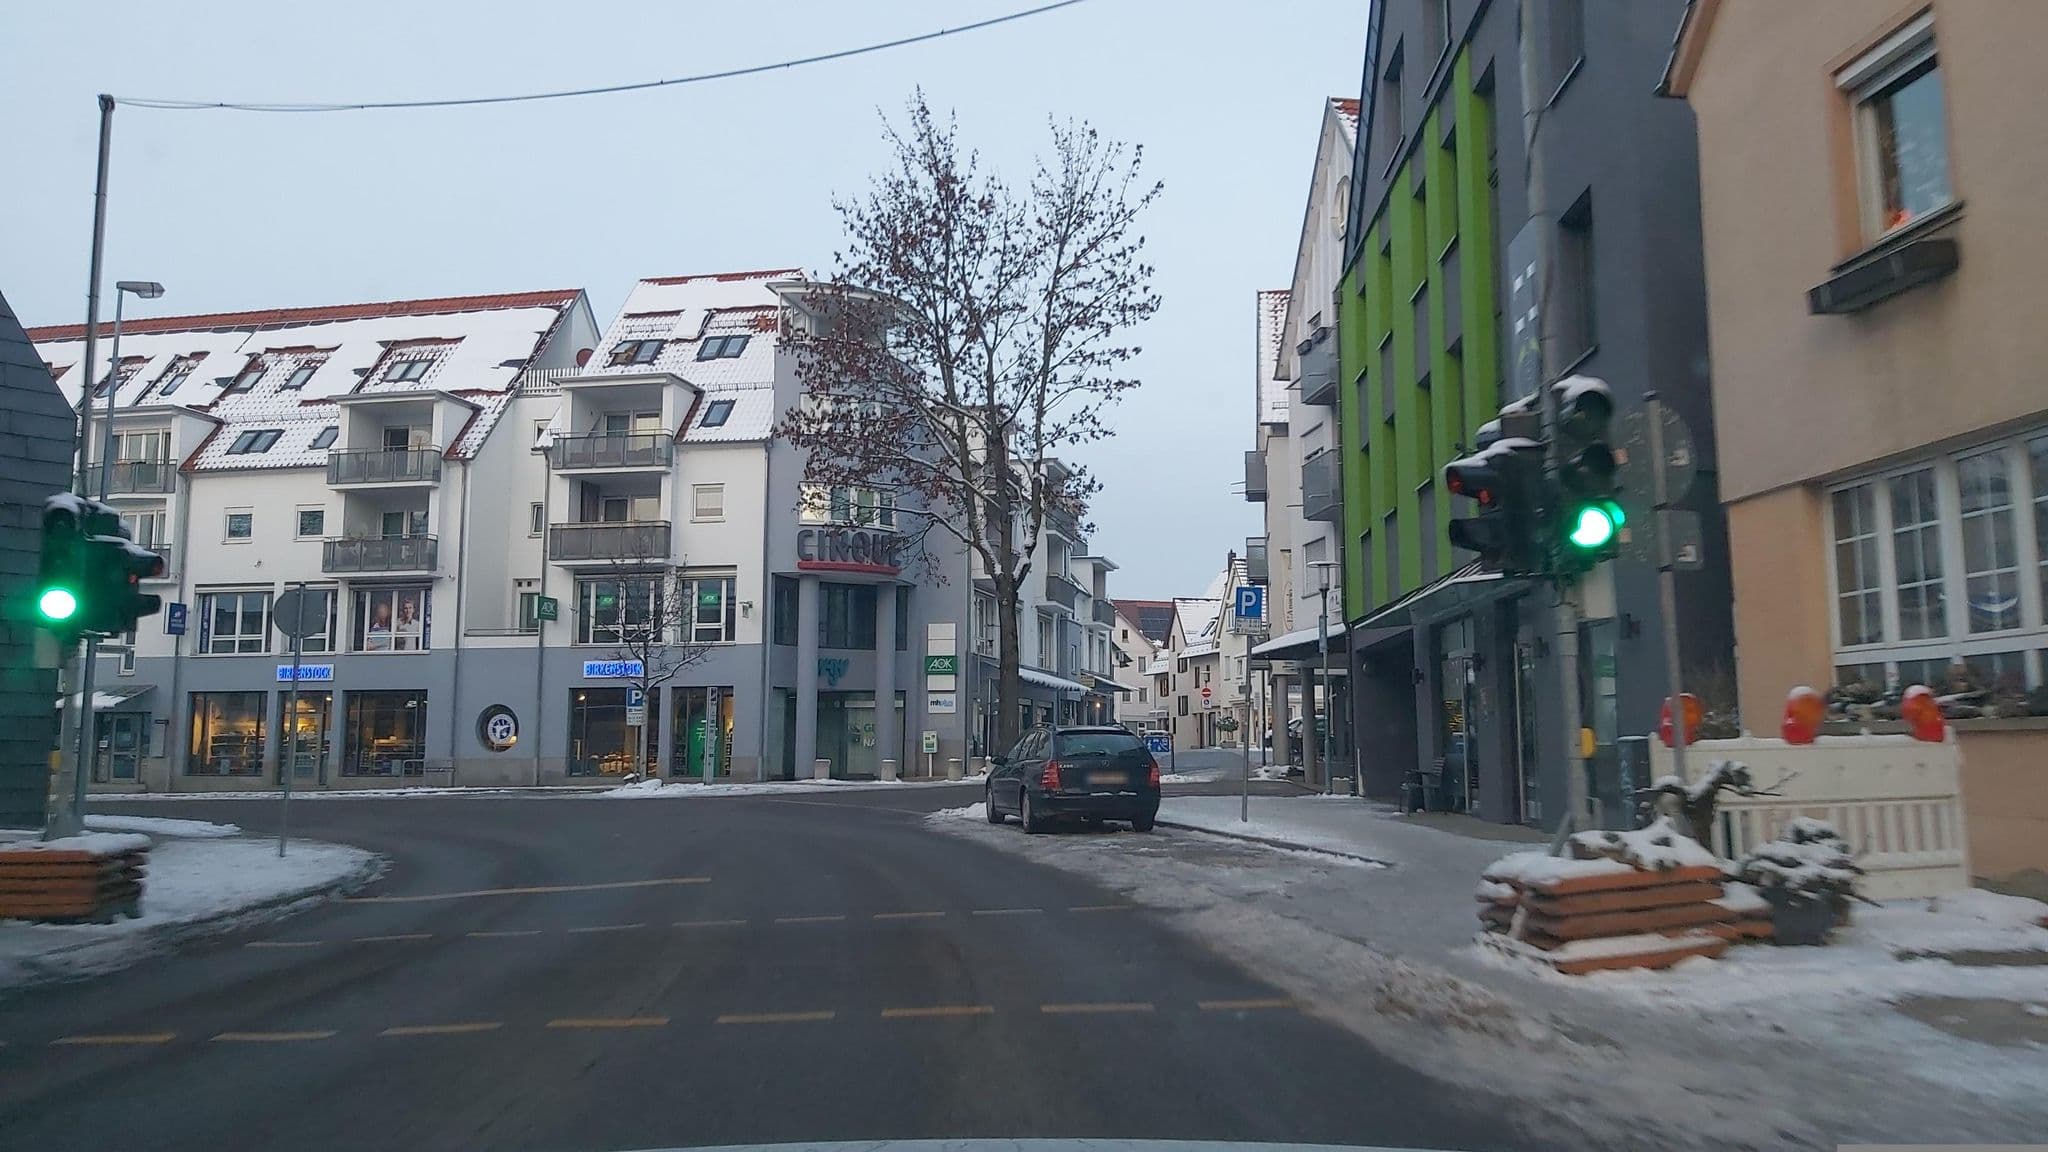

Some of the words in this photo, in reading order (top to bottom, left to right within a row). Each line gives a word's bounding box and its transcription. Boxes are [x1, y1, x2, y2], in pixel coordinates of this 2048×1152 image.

[1241, 591, 1256, 615] P
[929, 658, 952, 669] AOK
[279, 666, 330, 679] BIRENSTOCK
[631, 690, 643, 704] P
